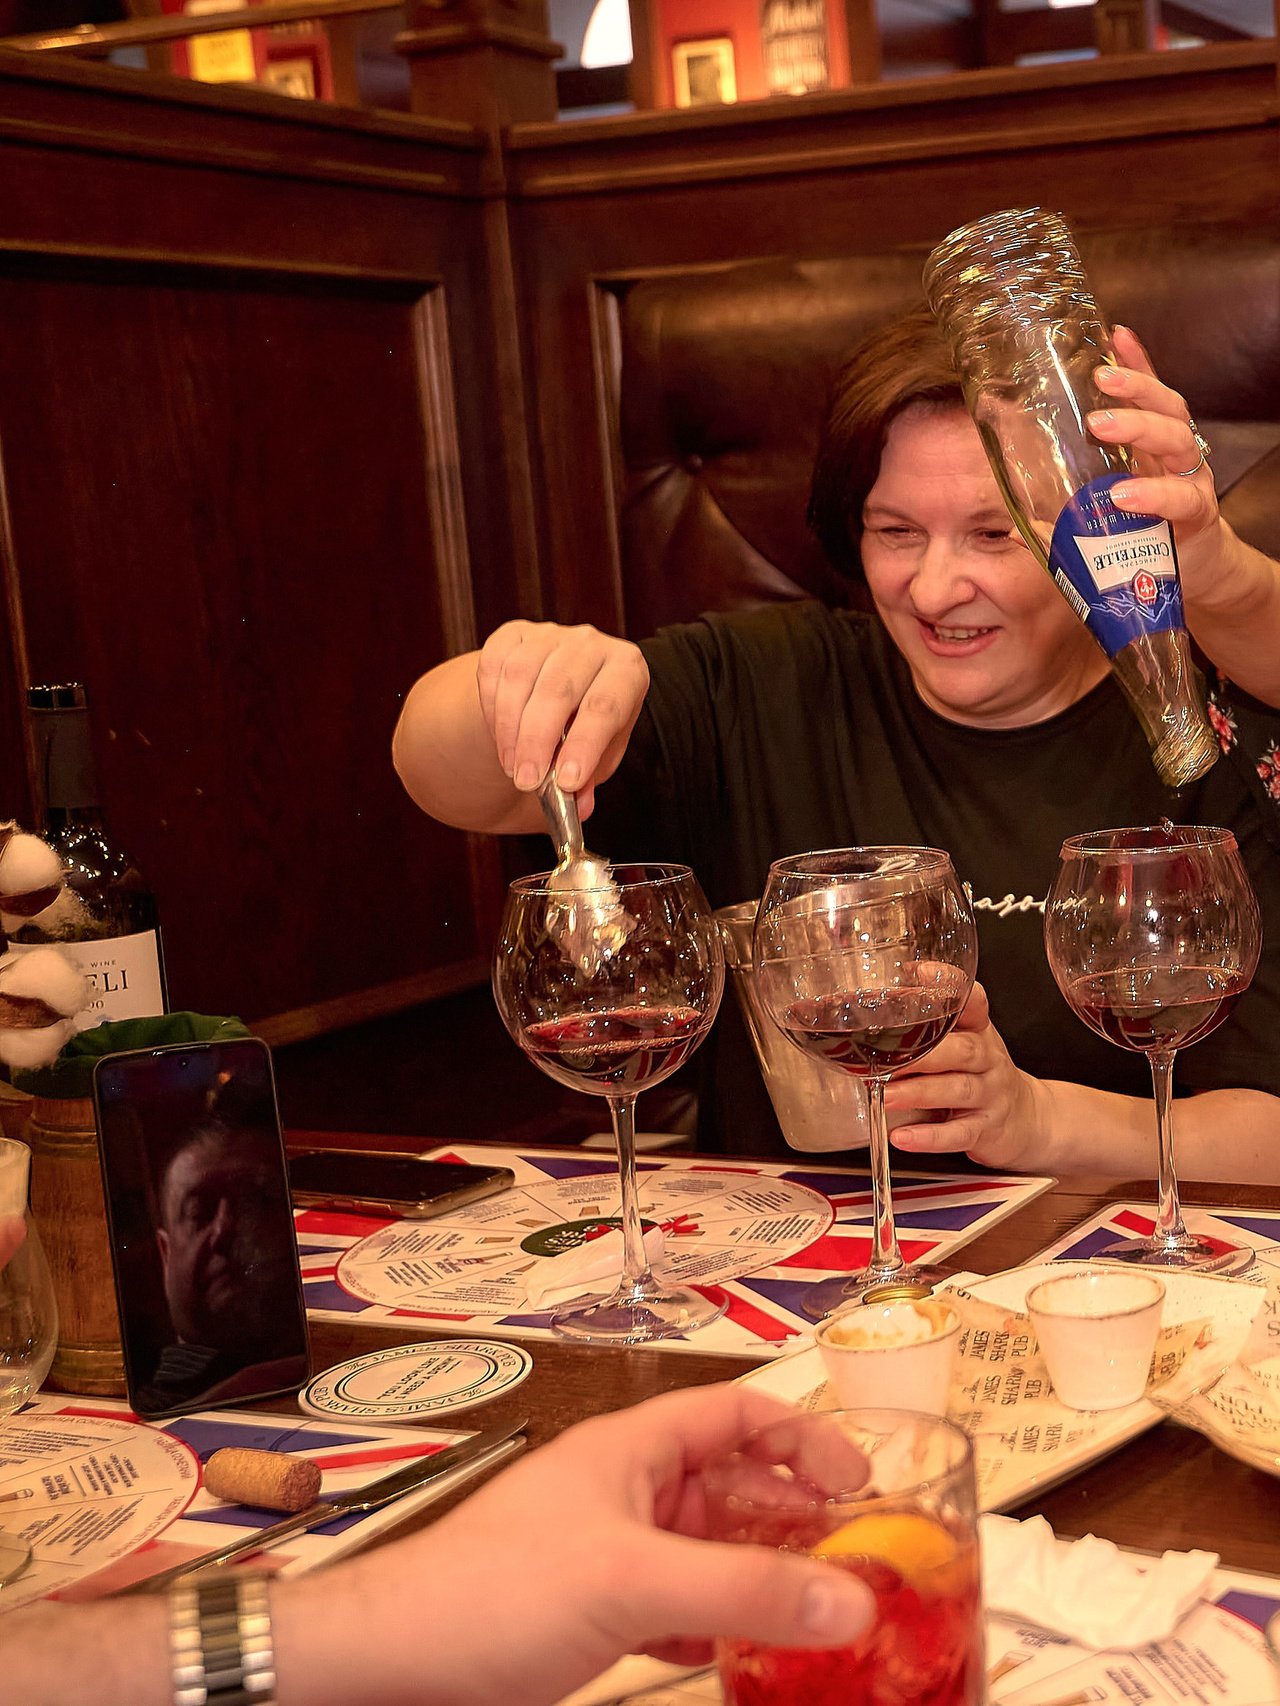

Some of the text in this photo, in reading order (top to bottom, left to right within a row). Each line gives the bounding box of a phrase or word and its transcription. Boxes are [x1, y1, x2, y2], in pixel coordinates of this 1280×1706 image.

[1093, 542, 1170, 570] CRISTELLE
[989, 1331, 1010, 1362] SHARK
[1011, 1335, 1029, 1357] PUB
[1024, 1379, 1042, 1399] PUB
